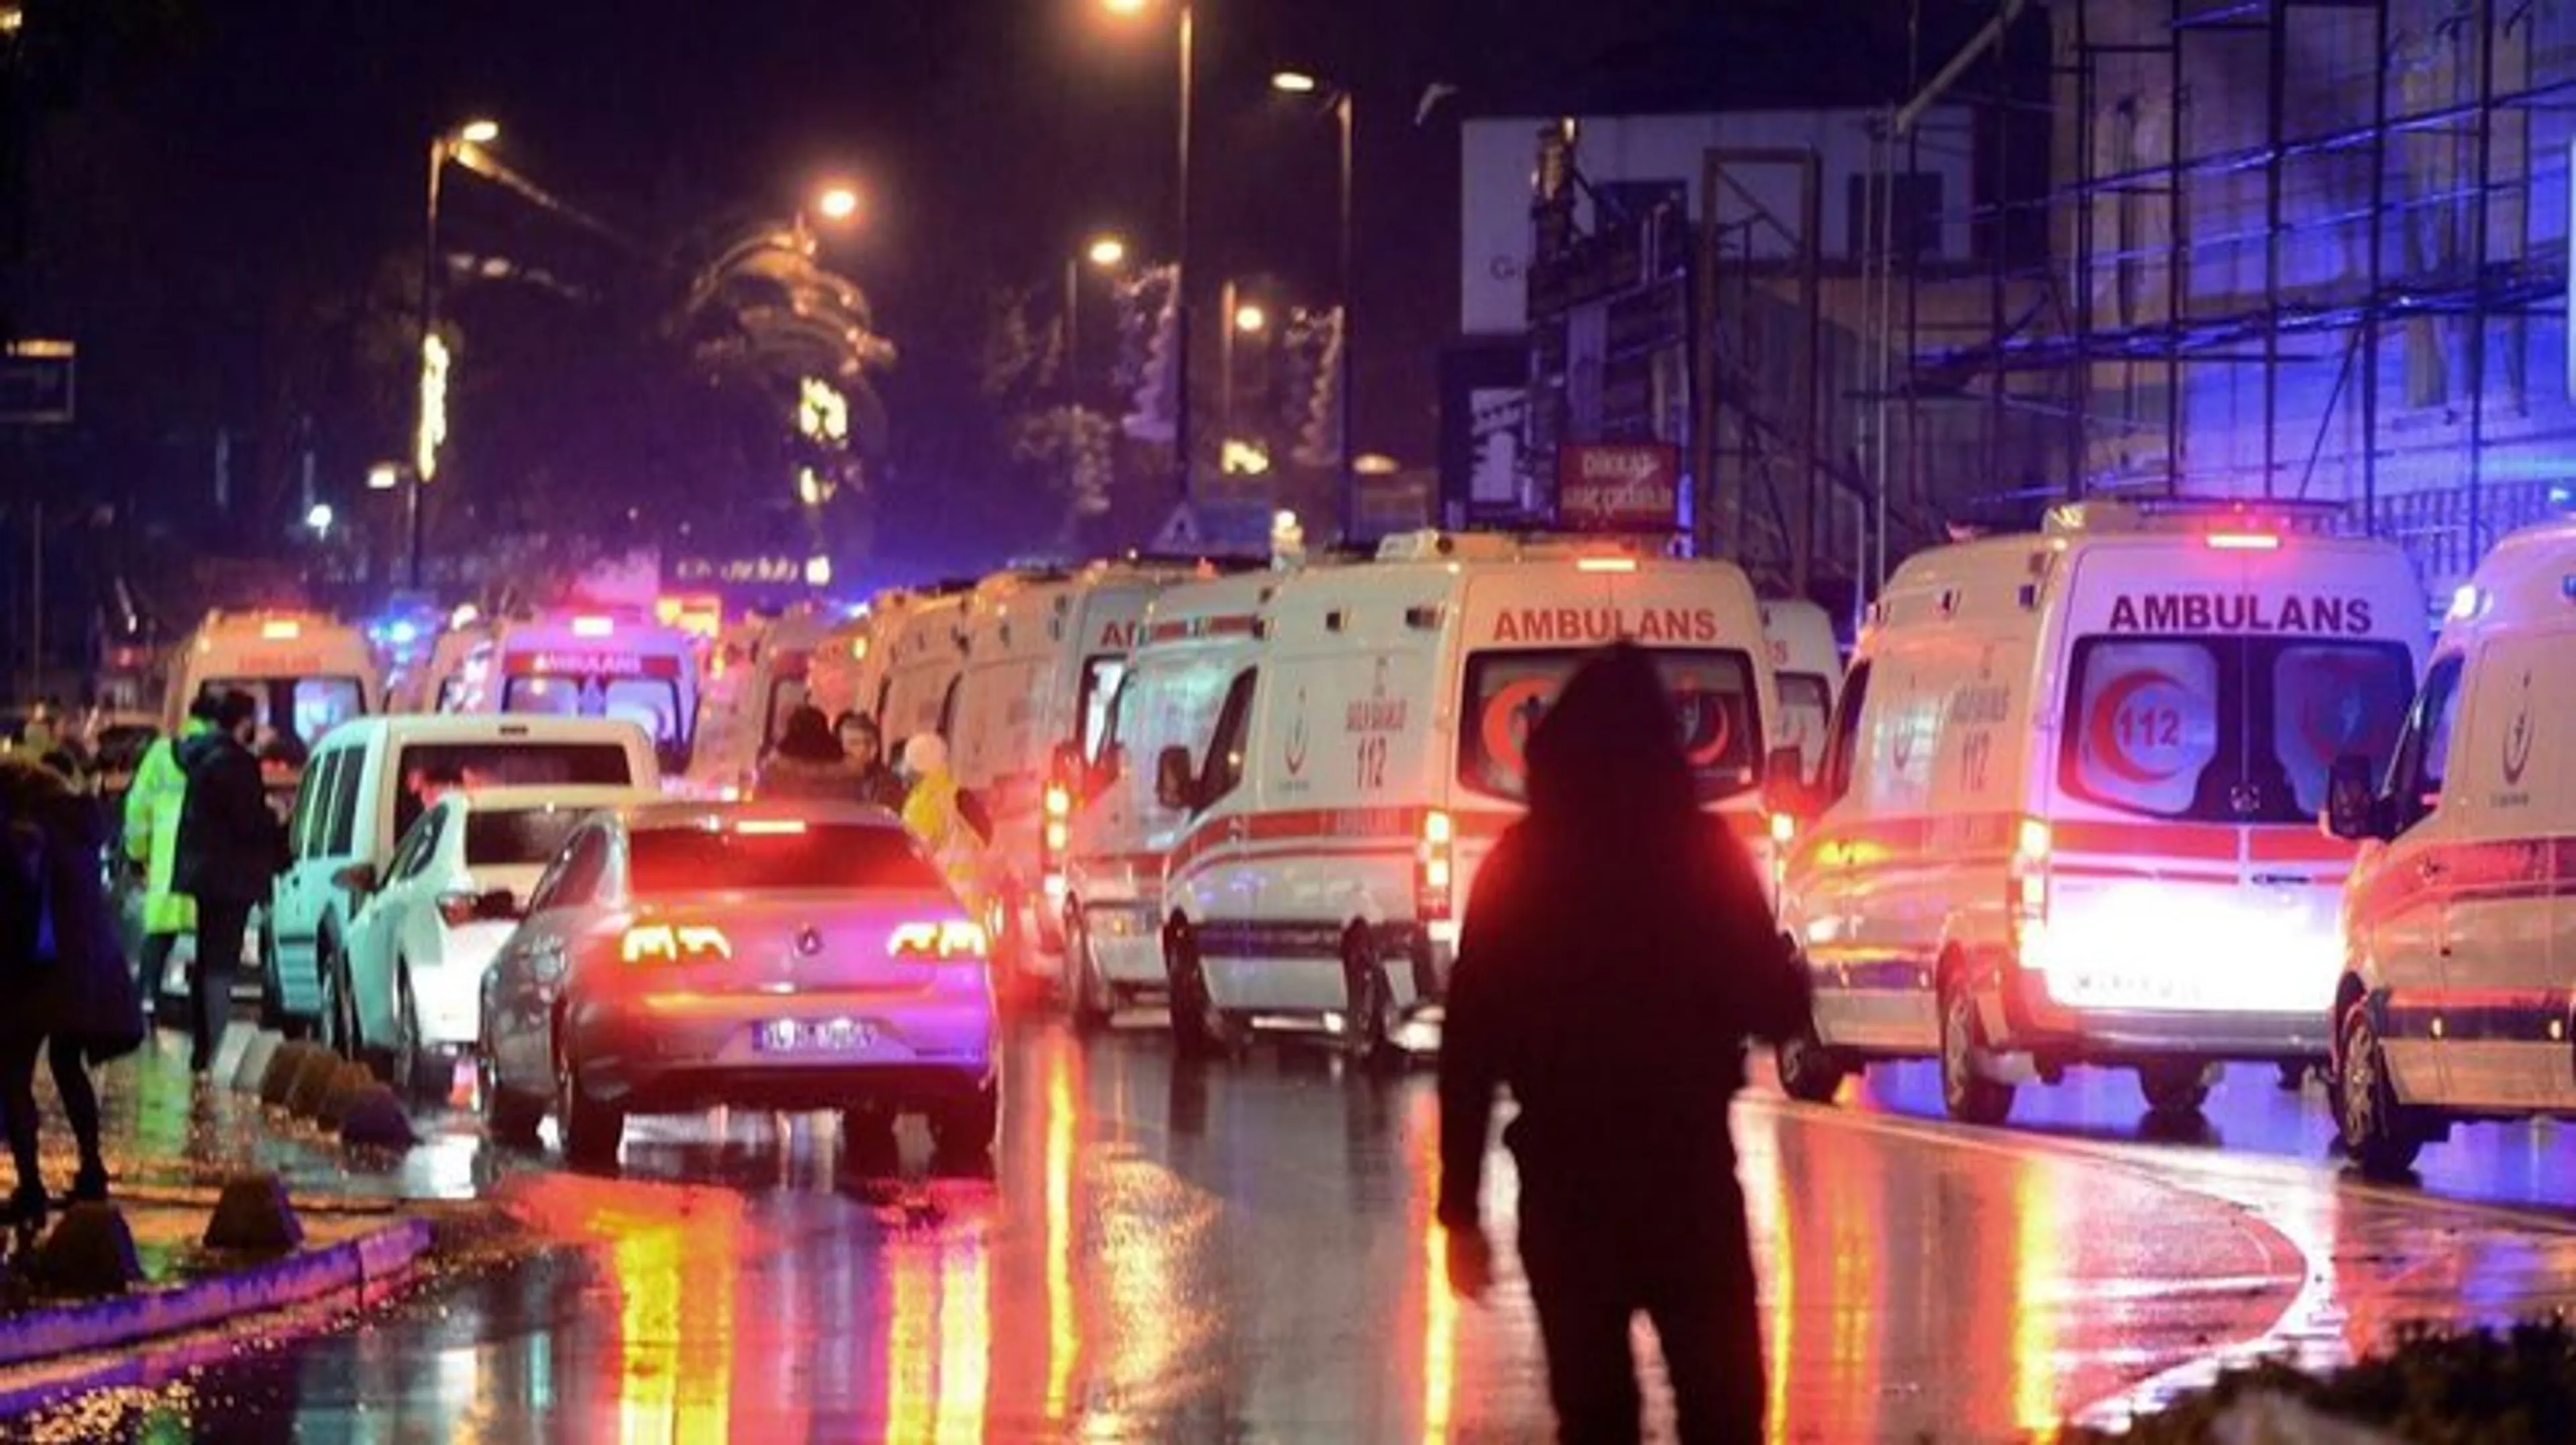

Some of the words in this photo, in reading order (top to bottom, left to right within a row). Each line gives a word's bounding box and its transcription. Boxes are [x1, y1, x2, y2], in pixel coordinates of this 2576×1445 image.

[1494, 608, 1717, 641] AMBULANS
[2109, 594, 2374, 634] AMBULANS
[2120, 706, 2179, 747] 112
[1356, 735, 1387, 788] 112
